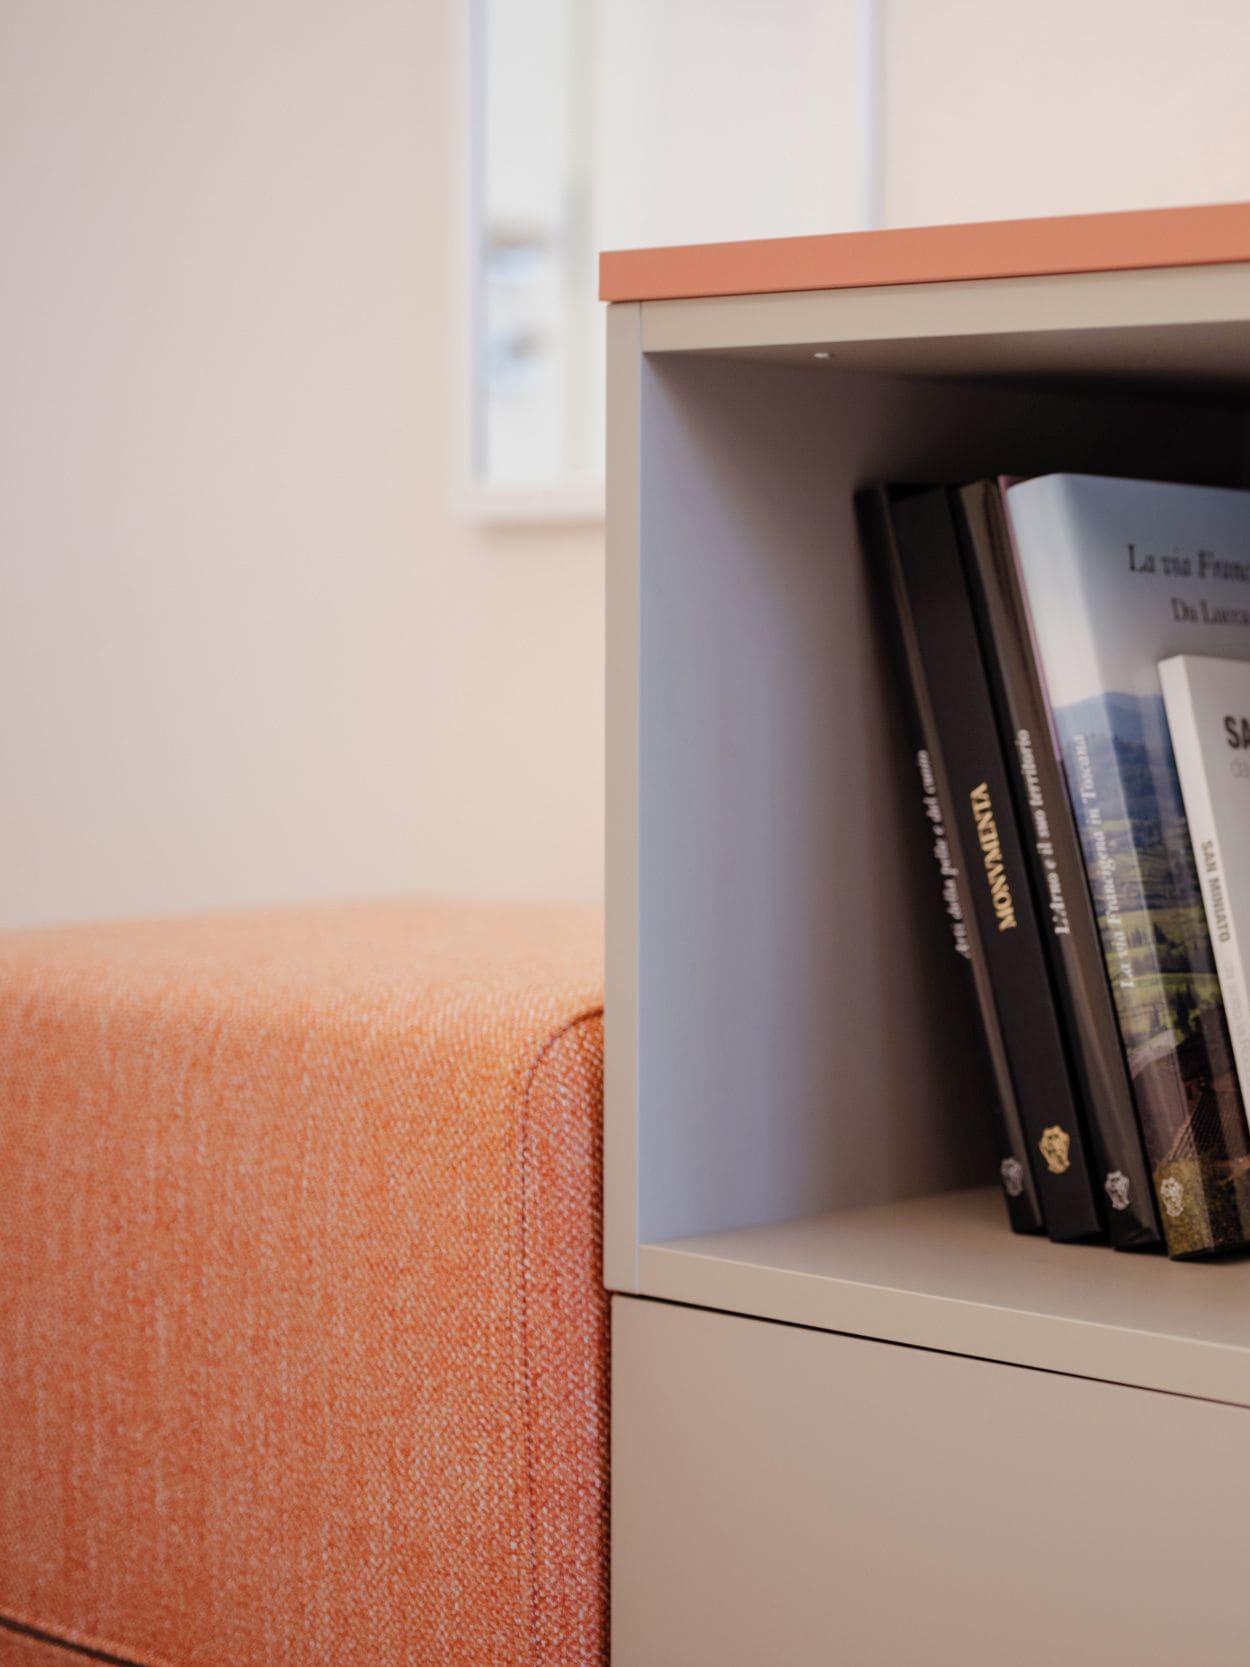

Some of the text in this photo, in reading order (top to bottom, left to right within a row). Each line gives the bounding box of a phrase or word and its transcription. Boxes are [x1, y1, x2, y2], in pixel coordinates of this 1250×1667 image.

[1128, 543, 1155, 574] La
[969, 782, 1017, 931] MONVMENTA
[1201, 840, 1231, 943] SAN MINIATO
